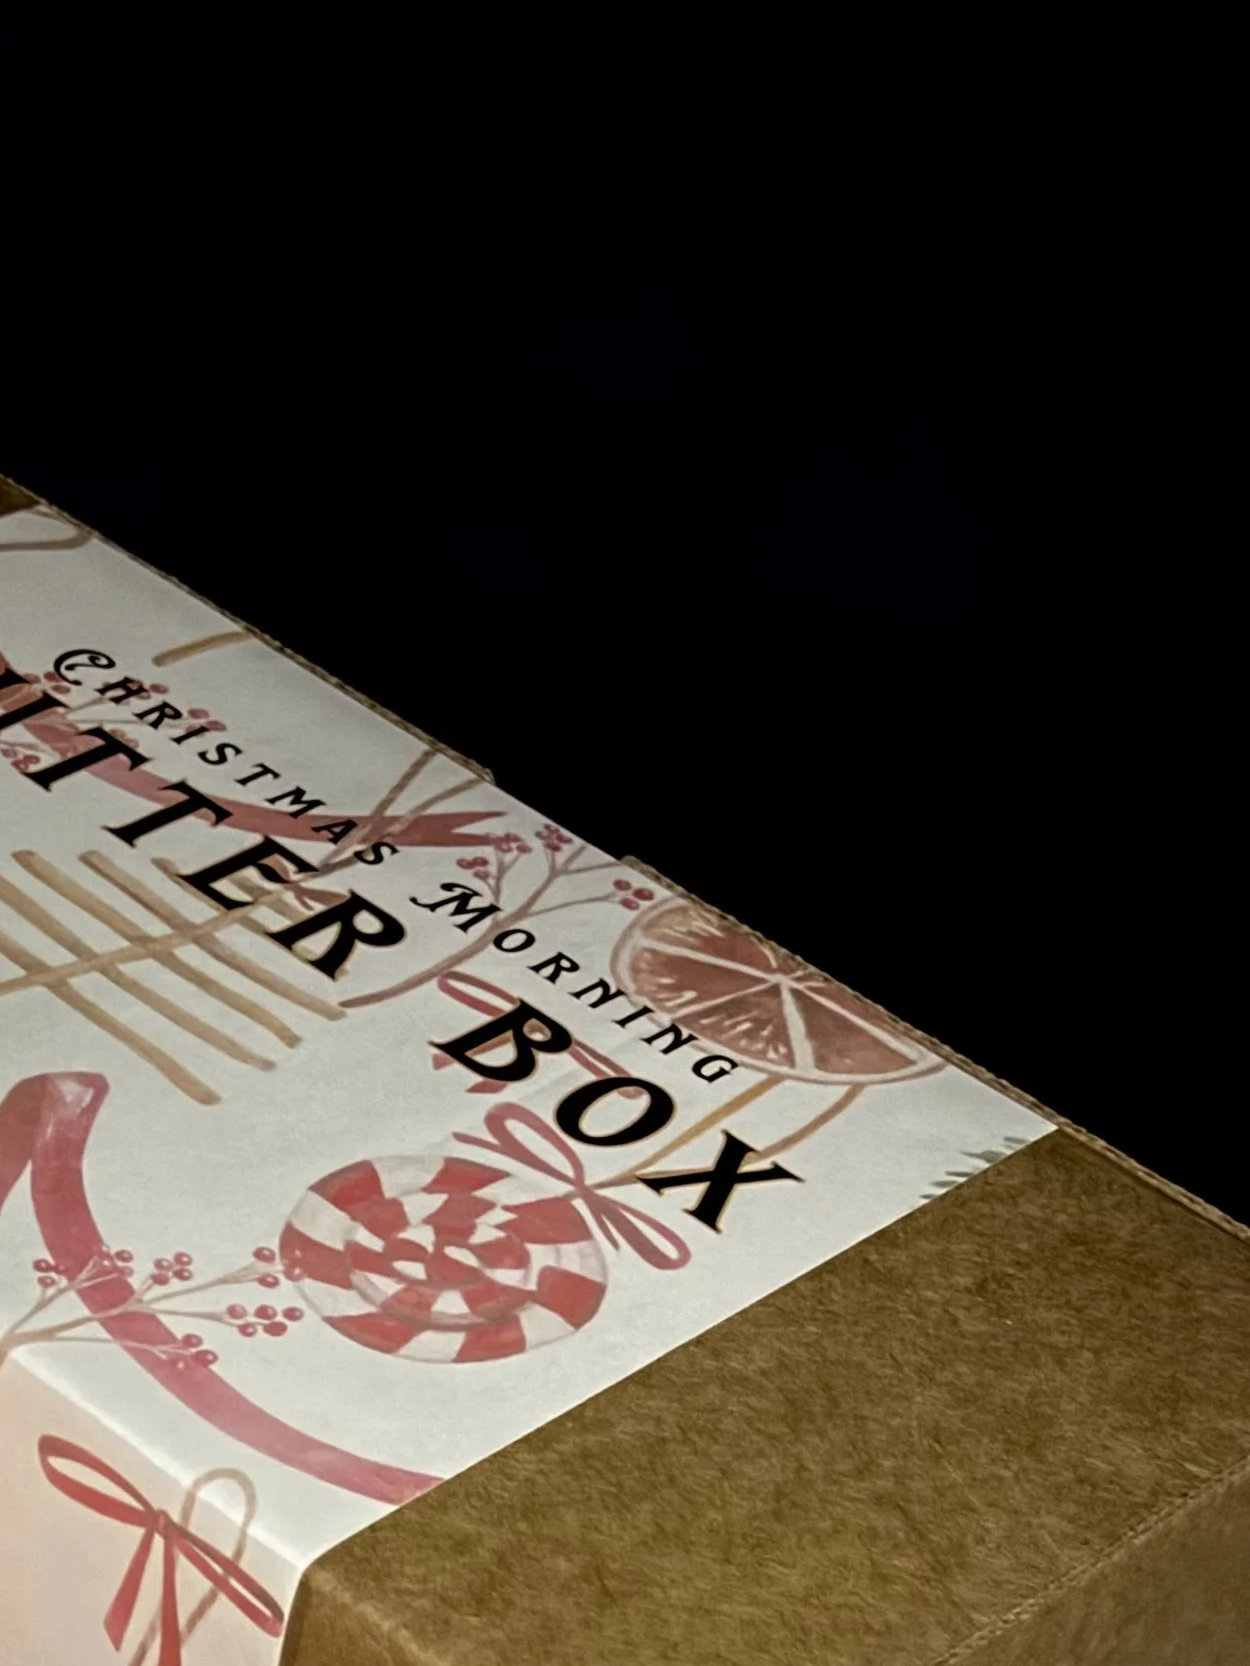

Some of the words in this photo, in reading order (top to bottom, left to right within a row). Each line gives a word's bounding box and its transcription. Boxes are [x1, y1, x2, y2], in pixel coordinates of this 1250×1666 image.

[52, 648, 400, 867] CHRISTMAS
[408, 881, 741, 1084] MORNING
[427, 997, 806, 1235] BOX
